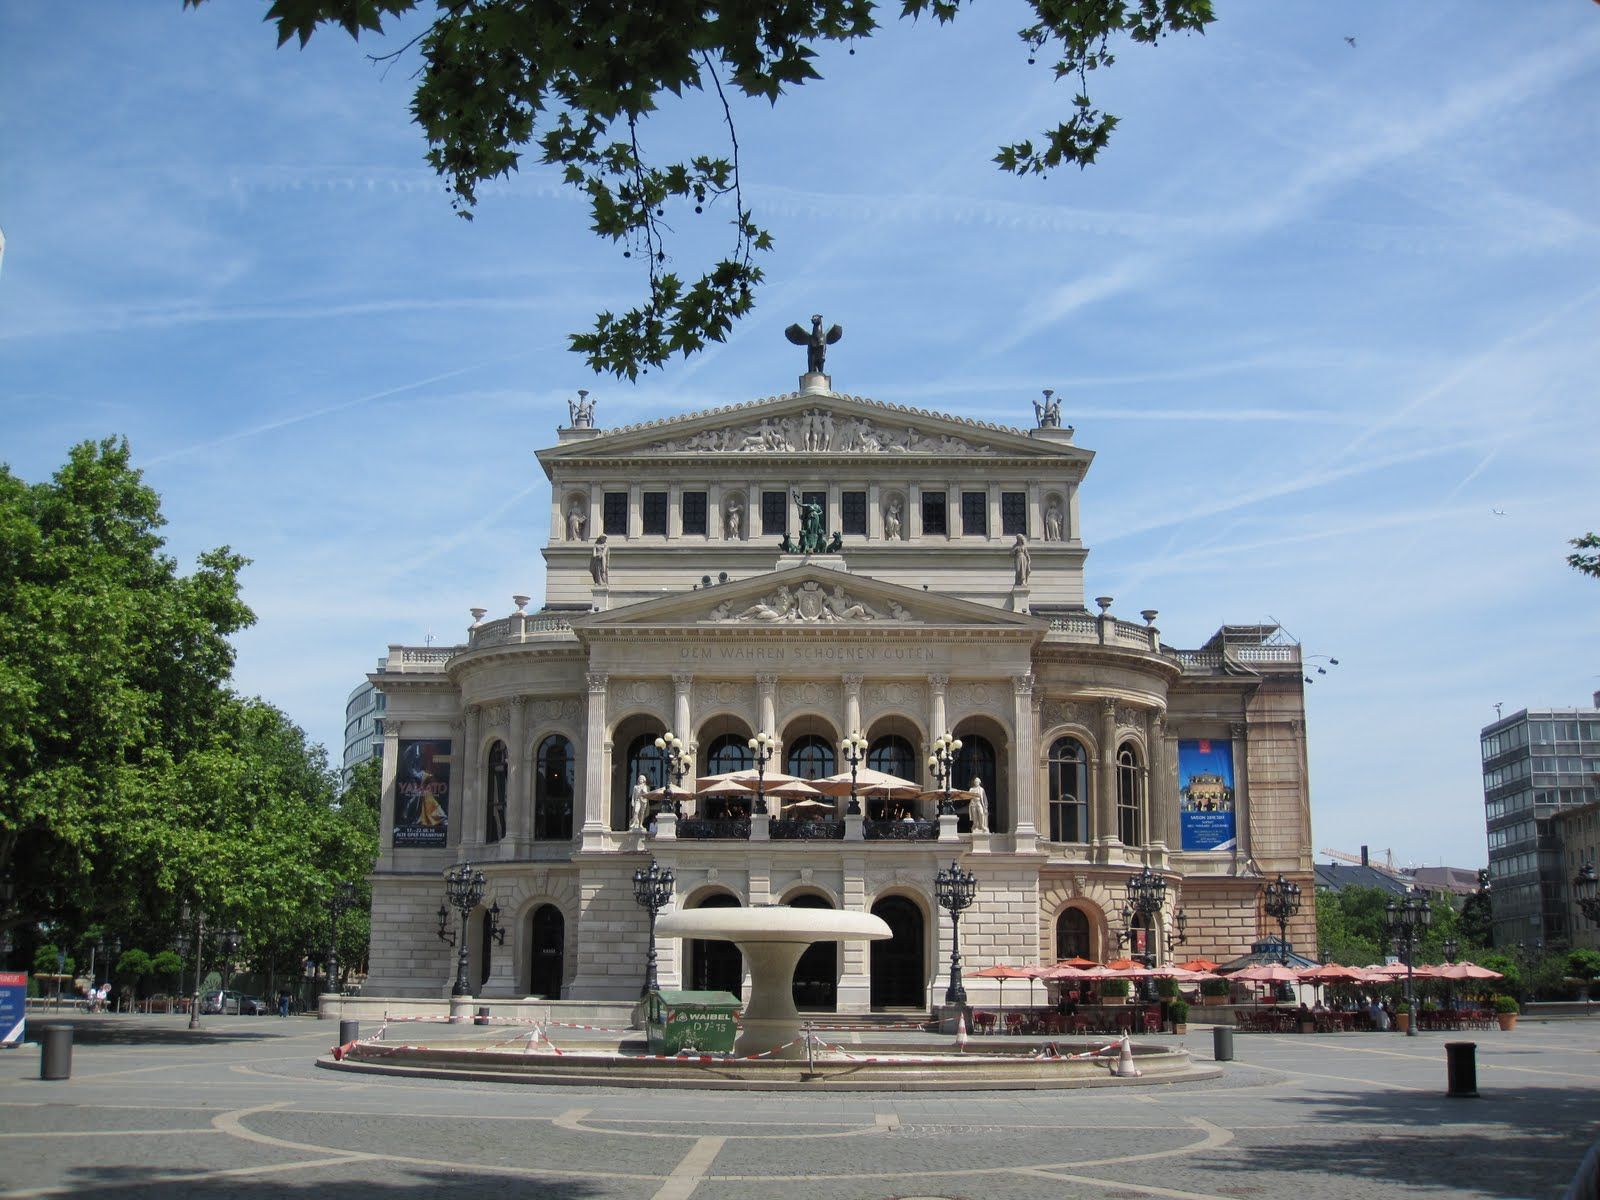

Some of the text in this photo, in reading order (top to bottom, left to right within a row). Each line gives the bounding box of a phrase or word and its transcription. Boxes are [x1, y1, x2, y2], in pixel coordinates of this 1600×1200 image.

[680, 647, 712, 659] DEM
[719, 647, 785, 659] WAHREN
[793, 647, 875, 660] SCHOENEN
[689, 1013, 731, 1021] WAIBEL
